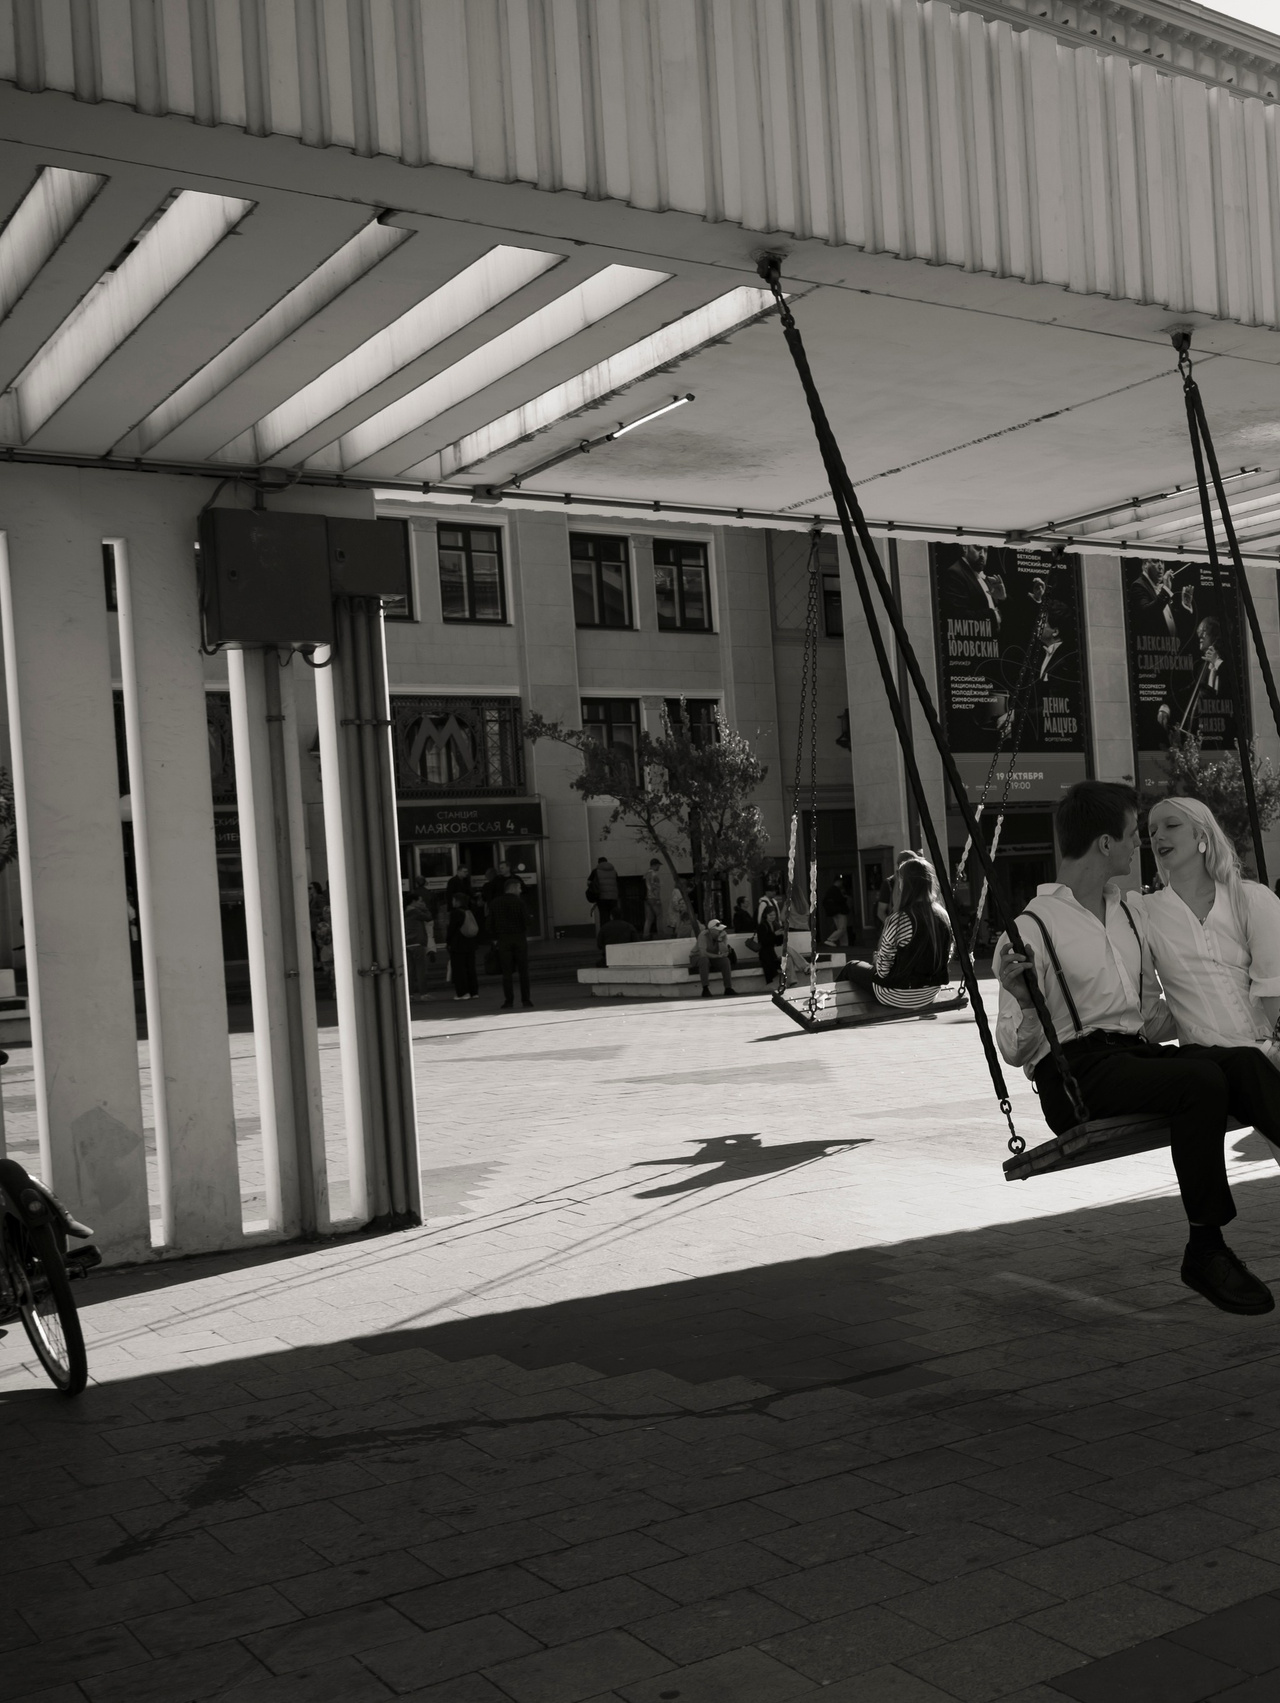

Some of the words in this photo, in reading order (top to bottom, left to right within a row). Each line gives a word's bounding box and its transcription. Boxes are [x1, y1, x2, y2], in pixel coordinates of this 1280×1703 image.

[1016, 553, 1042, 561] БЕТХОВЕН
[947, 618, 993, 640] ДМИТРИЙ
[948, 638, 1000, 659] ЮРОВСКИЙ
[1136, 635, 1181, 656] АЛЕКСАНДР
[1137, 653, 1194, 674] СЛАДКОВСКИЙ
[950, 682, 994, 690] НАЦИОНАЛЬНЫЙ
[1042, 696, 1071, 718] ДЕНИС
[1197, 698, 1234, 718] АЛЕКСАНД
[1043, 716, 1078, 738] МАЦУЕВ
[995, 772, 1005, 781] 19
[1010, 781, 1031, 790] 19:00
[1144, 778, 1155, 787] 12+
[436, 810, 479, 820] СТАНЦИЯ
[414, 821, 502, 835] МАЯКОВСКАЯ
[505, 819, 515, 831] 4
